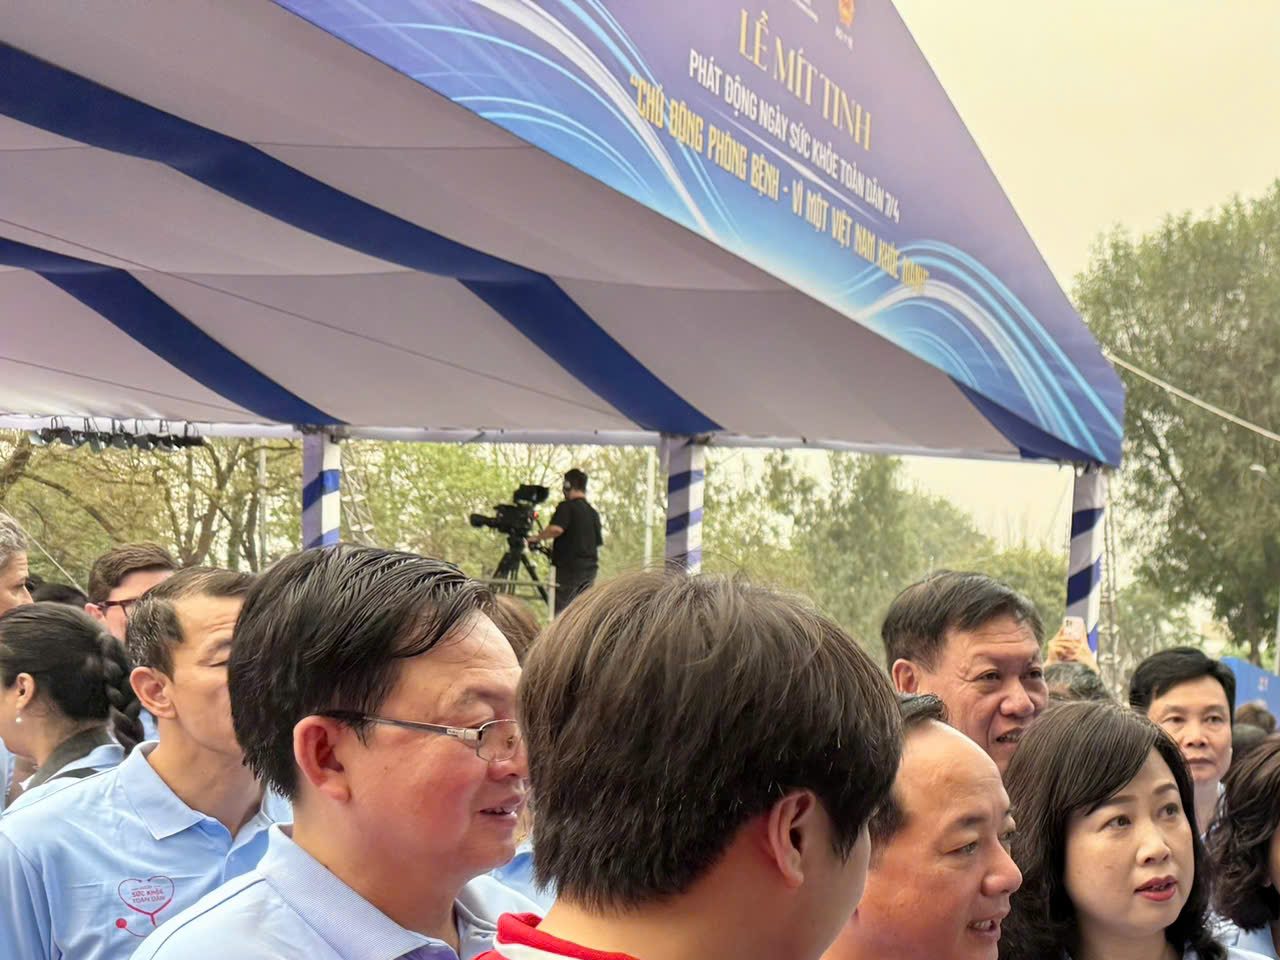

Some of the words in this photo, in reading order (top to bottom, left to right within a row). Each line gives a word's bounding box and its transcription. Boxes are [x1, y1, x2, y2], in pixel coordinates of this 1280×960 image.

[689, 48, 723, 95] PHÁT
[724, 74, 758, 121] ĐỘNG
[758, 99, 788, 142] NGÀY
[788, 121, 811, 160] SỨC
[773, 36, 818, 106] MÍT
[820, 73, 871, 151] TINH
